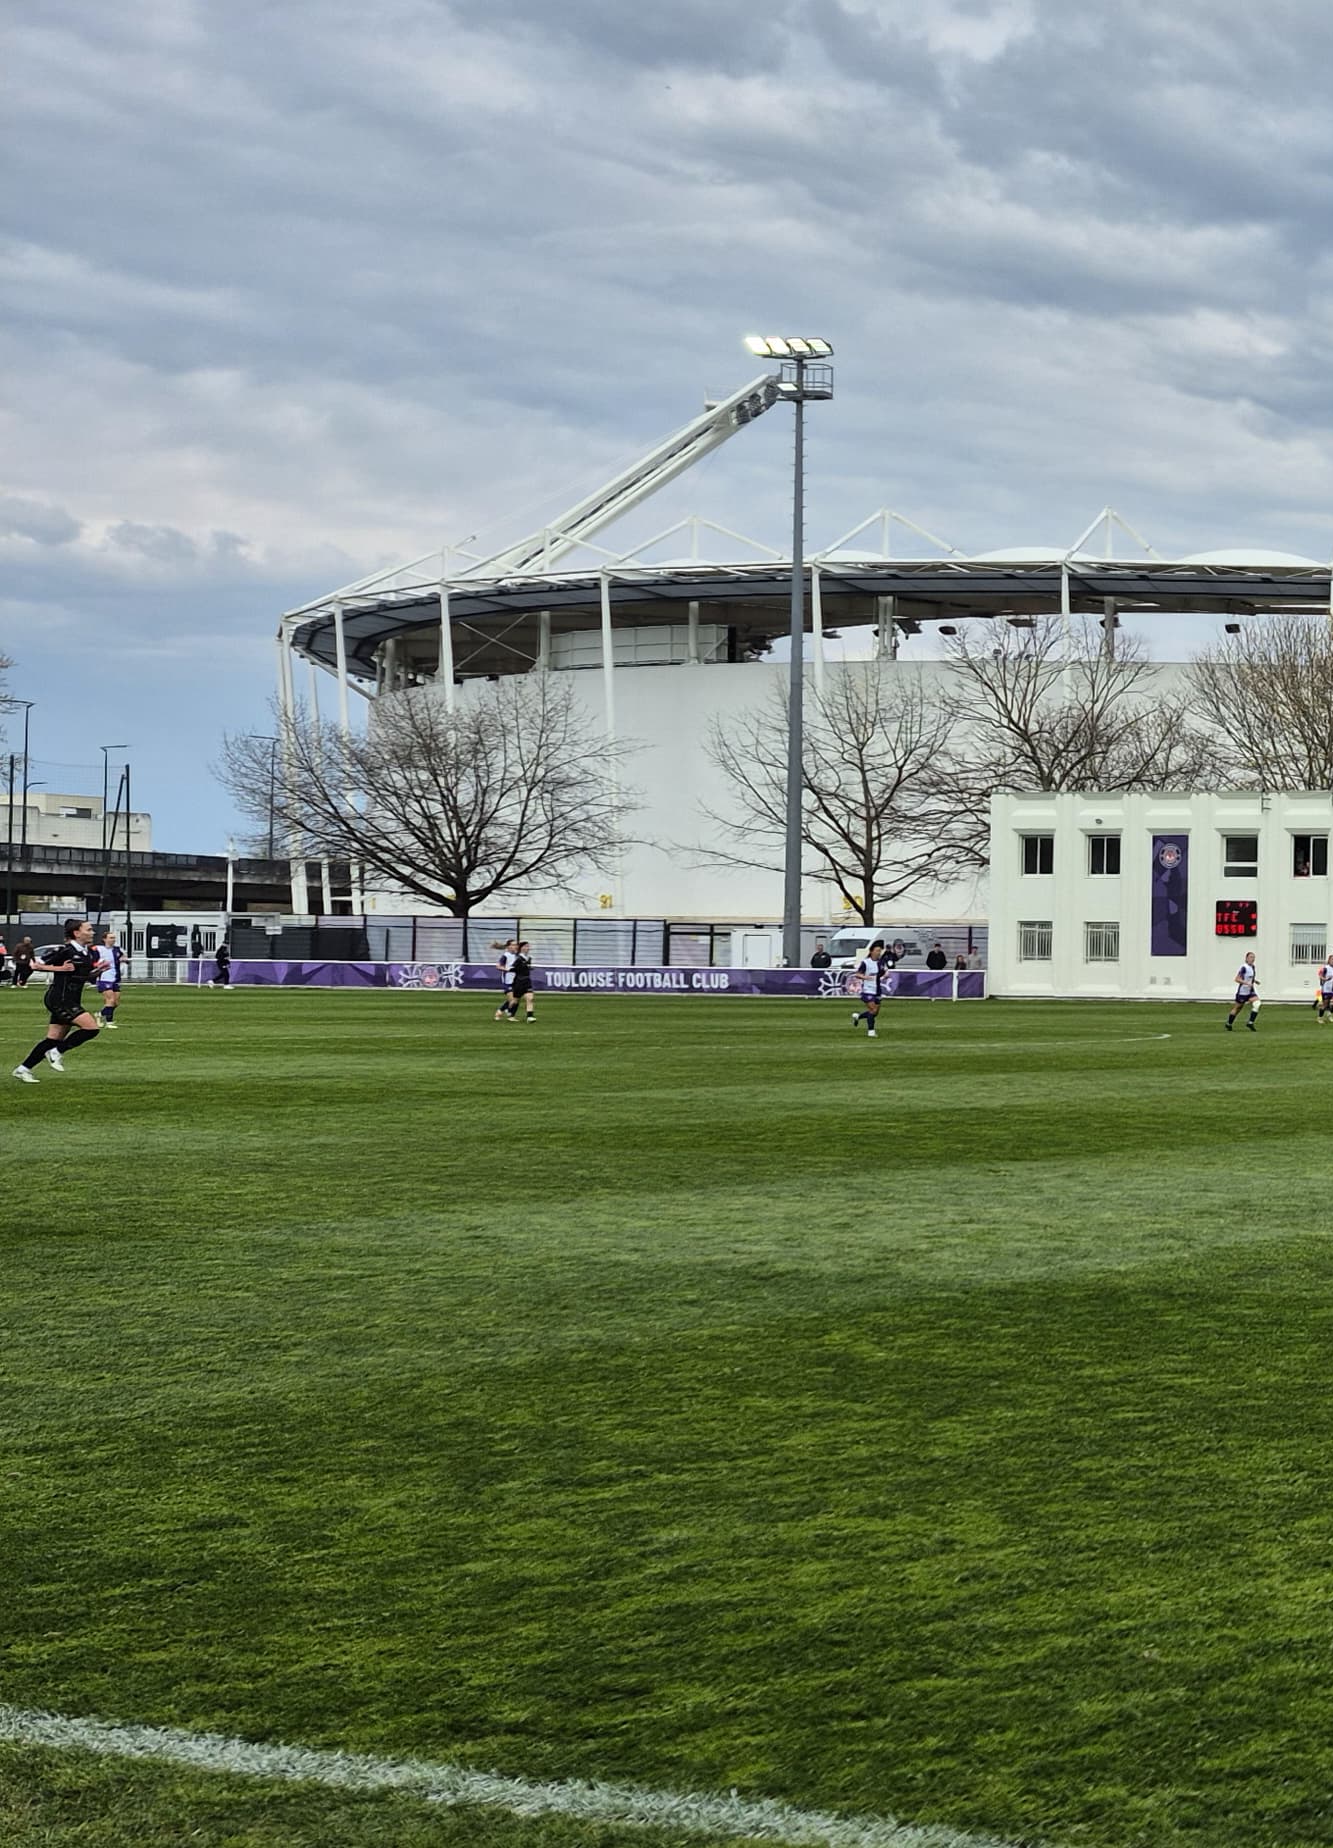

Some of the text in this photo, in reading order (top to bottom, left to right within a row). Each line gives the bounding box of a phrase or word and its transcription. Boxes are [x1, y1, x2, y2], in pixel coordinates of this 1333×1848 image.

[545, 971, 729, 989] TOULOUSE FOOTBALL CLUB
